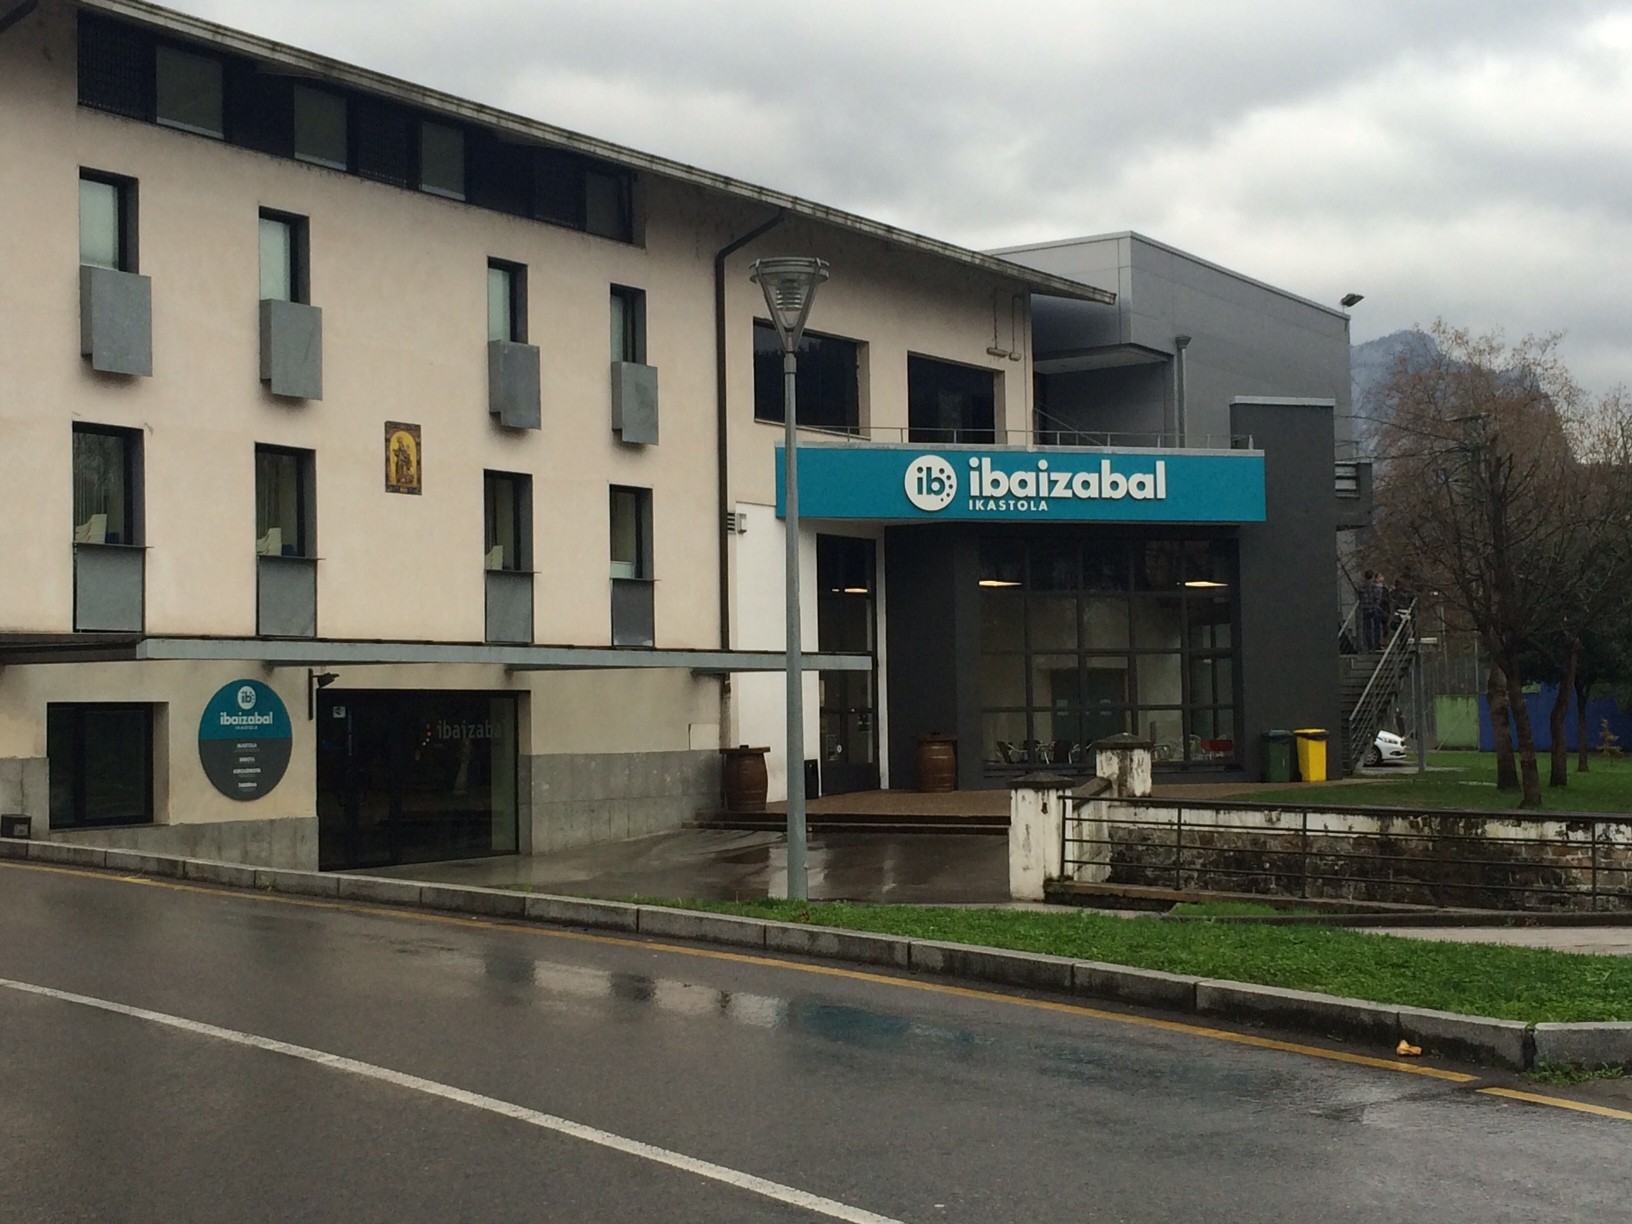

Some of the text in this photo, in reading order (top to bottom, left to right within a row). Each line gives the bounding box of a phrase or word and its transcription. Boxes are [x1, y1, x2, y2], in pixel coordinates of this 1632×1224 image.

[915, 466, 945, 496] ib
[969, 457, 1166, 499] ibaizabal
[968, 500, 1049, 511] IKASTOLA
[220, 712, 273, 725] ibaizabal
[436, 719, 504, 739] ibaizaba
